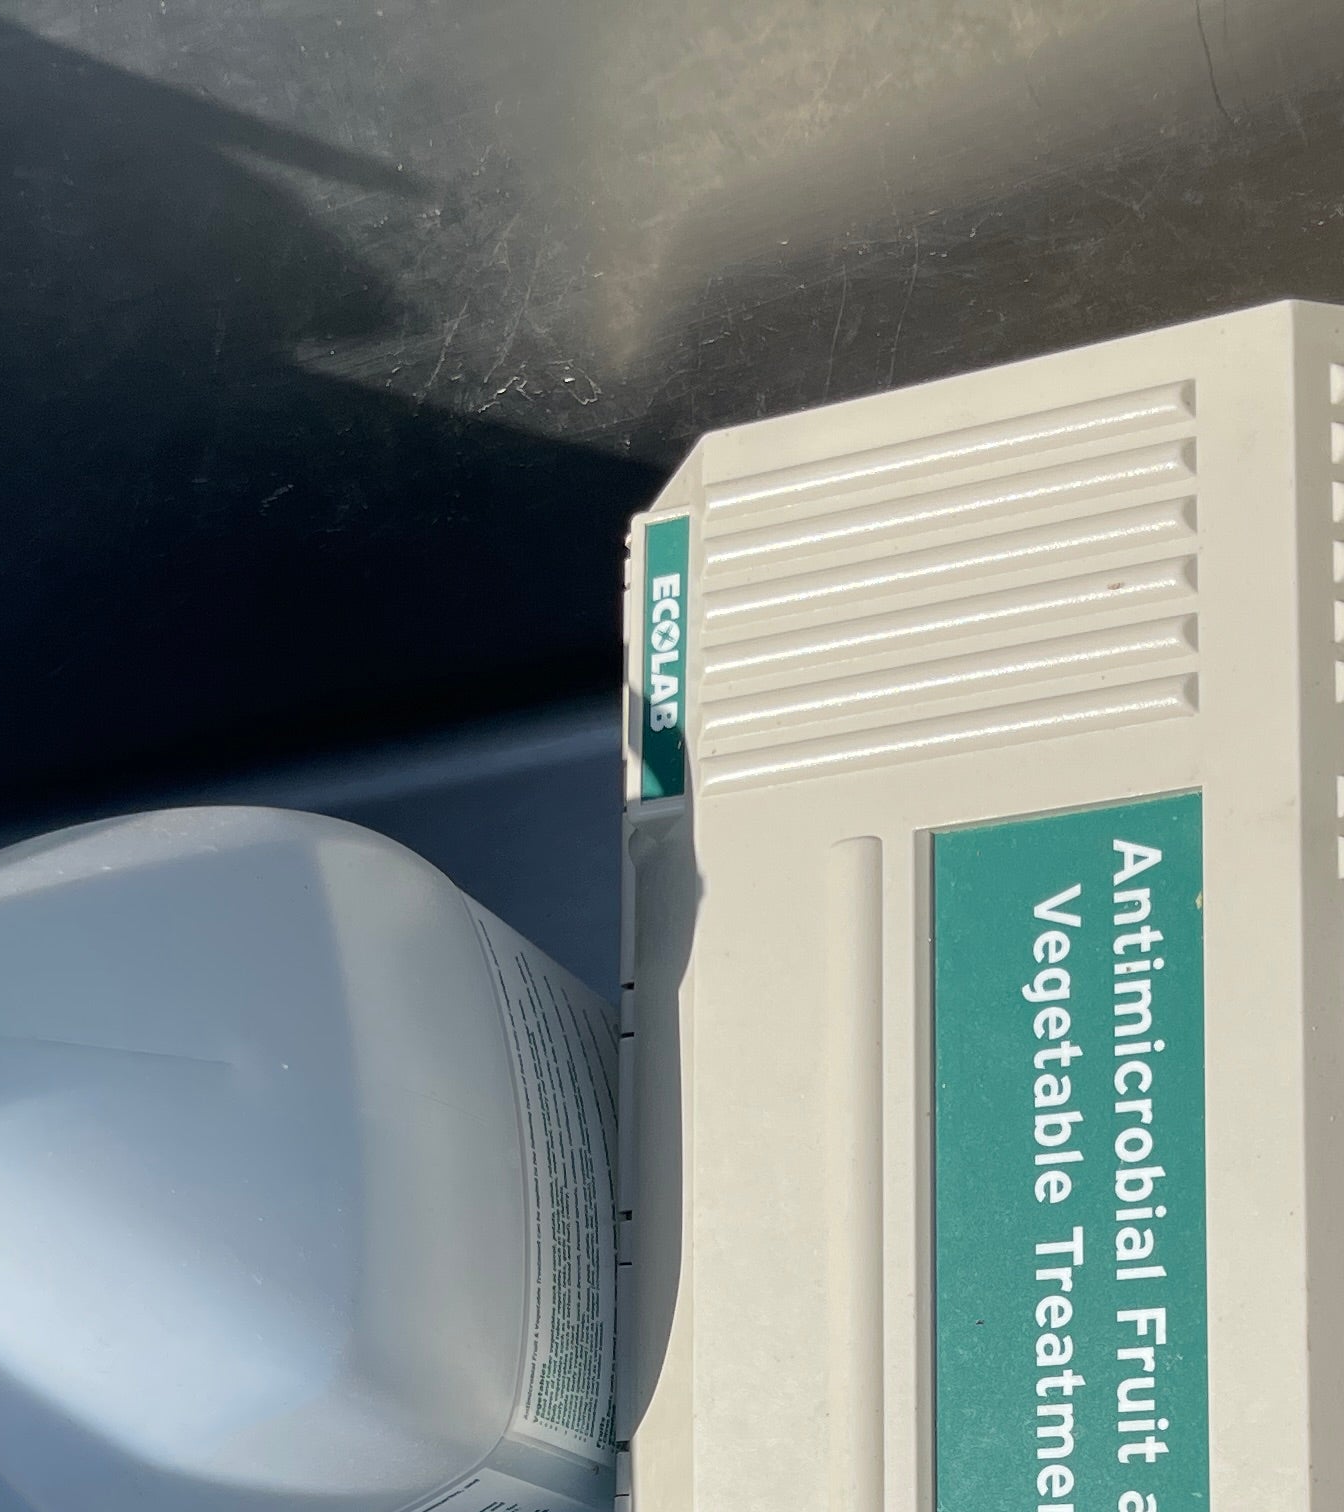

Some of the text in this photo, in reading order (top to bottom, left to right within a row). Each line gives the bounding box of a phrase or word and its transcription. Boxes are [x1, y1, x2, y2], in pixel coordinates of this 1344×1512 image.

[650, 573, 681, 732] ECOLAB
[1022, 883, 1084, 1203] Vegetable
[1113, 839, 1167, 1281] Antimicrobial
[1116, 1307, 1169, 1464] Fruit
